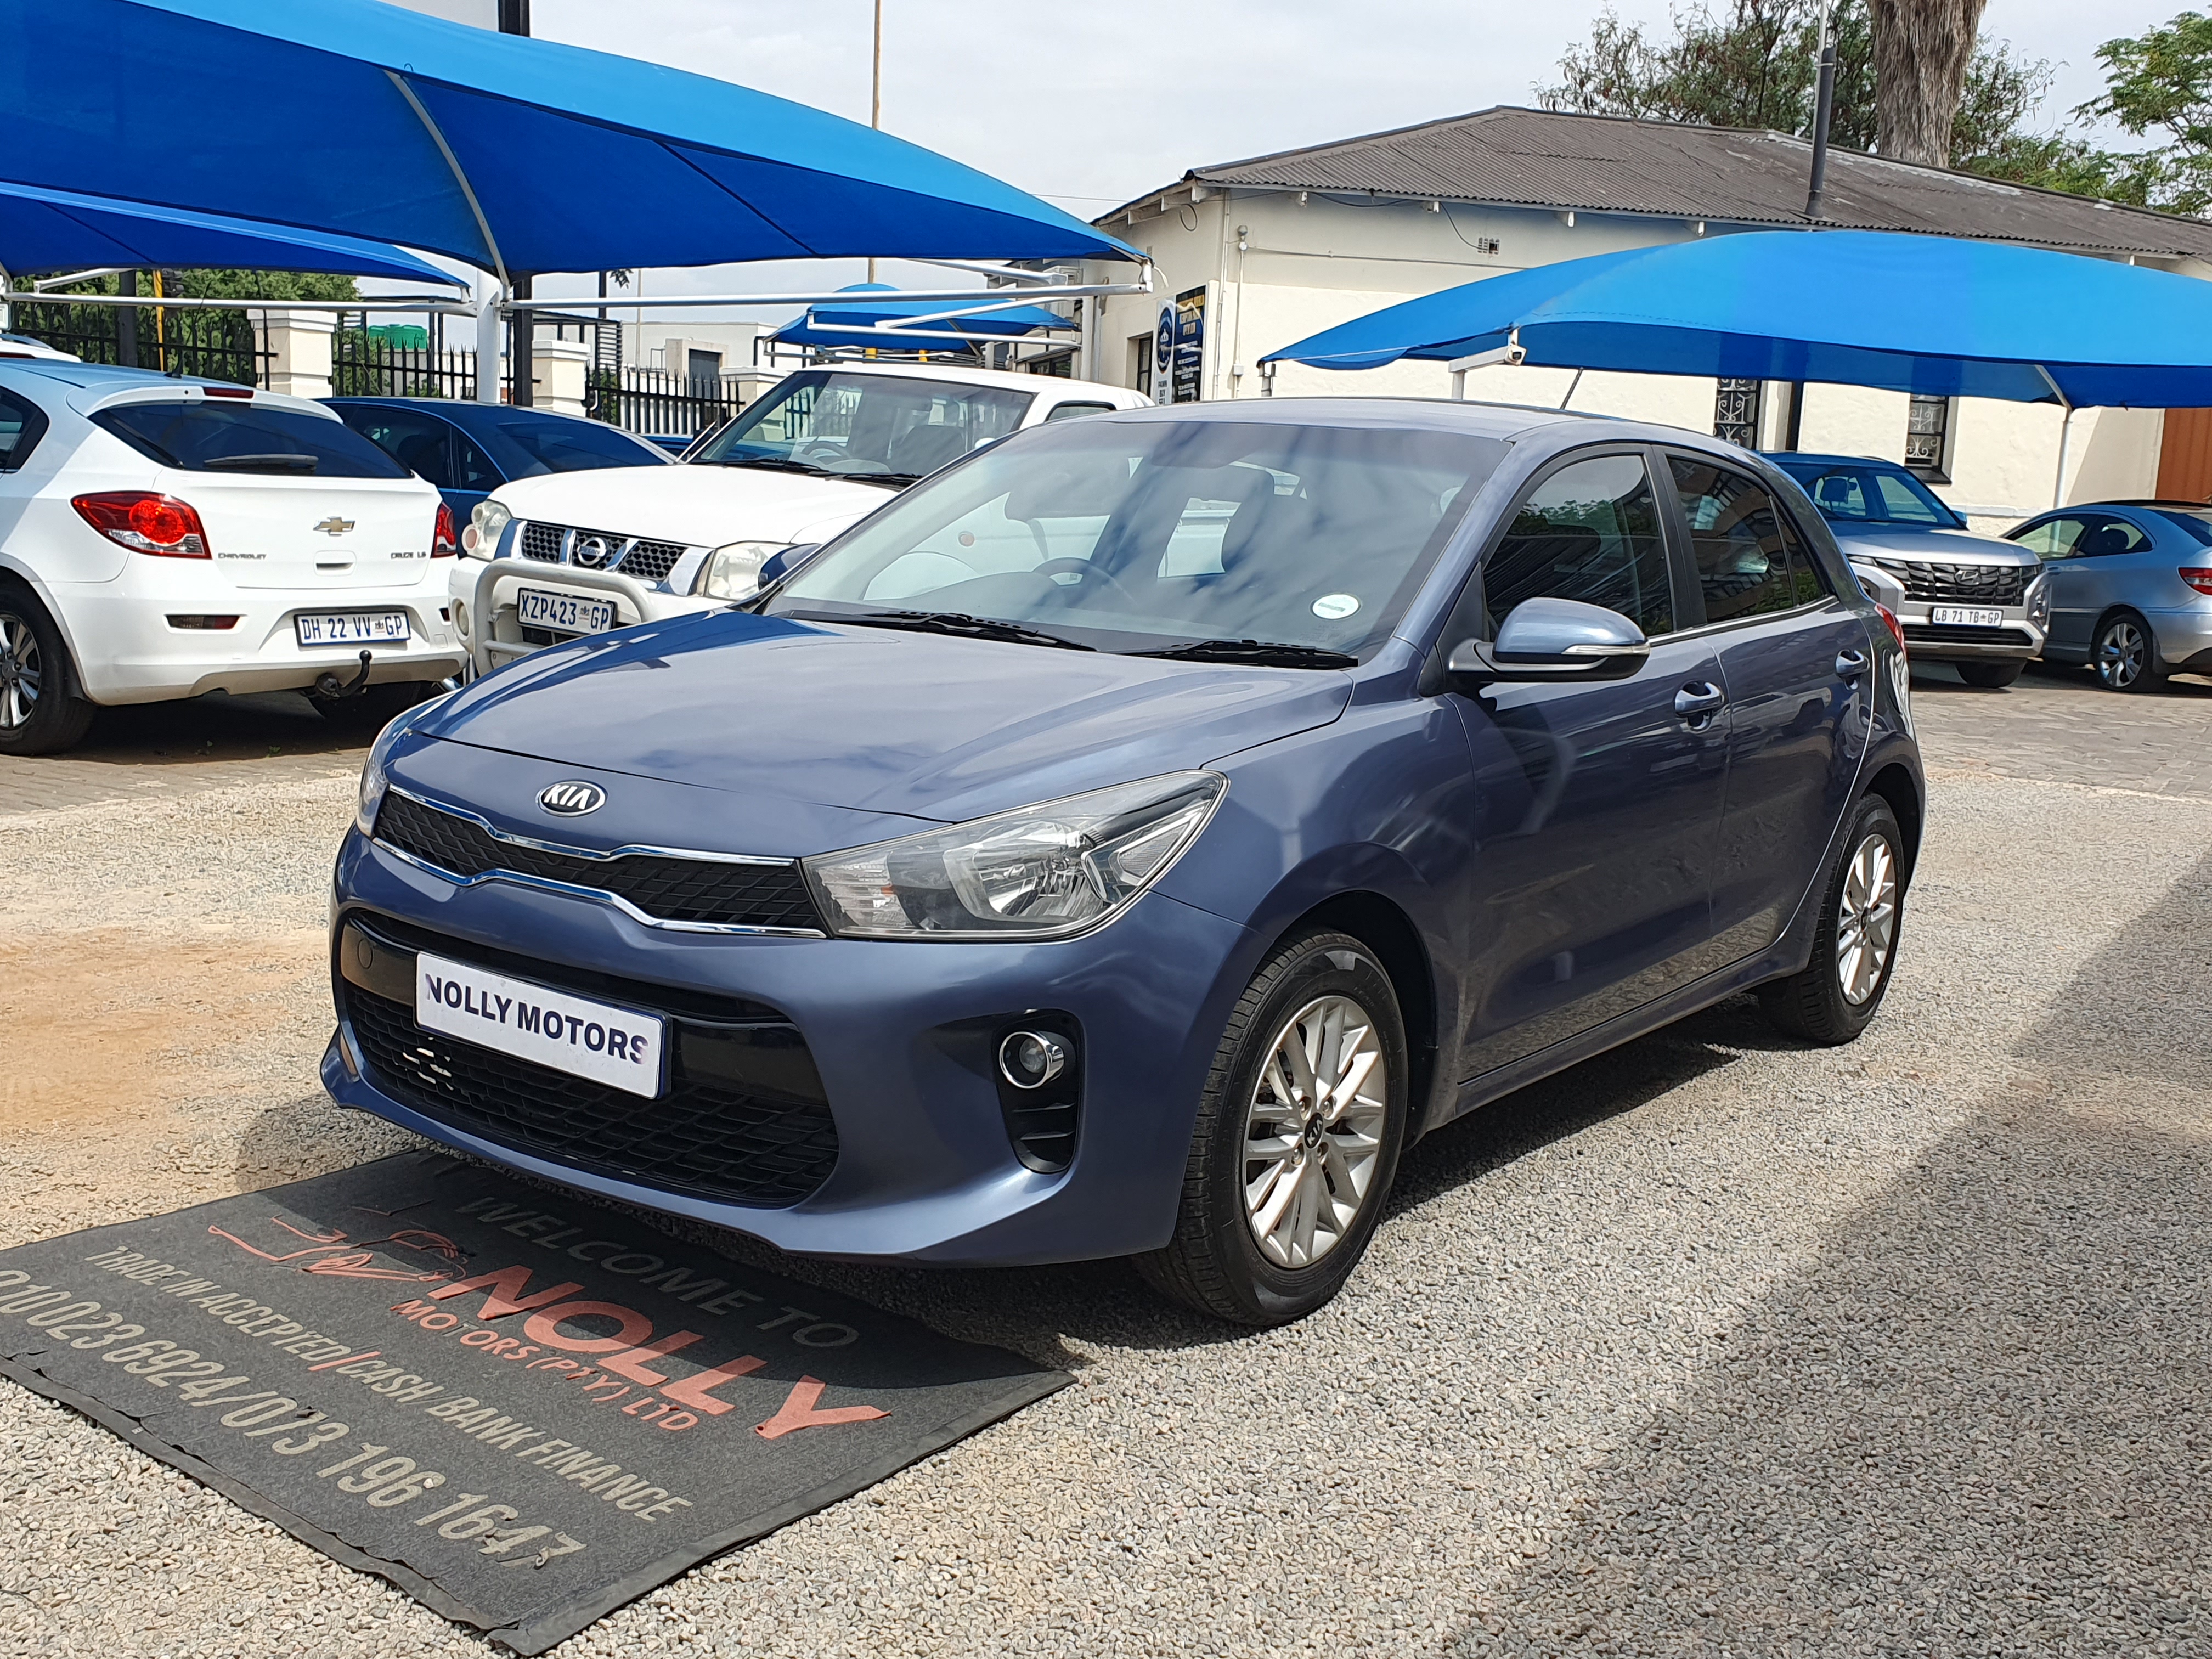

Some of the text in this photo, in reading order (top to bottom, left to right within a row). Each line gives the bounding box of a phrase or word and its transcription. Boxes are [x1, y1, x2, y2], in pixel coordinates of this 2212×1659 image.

[301, 615, 402, 640] DH 22 VV GP
[521, 594, 609, 631] XZP423 GP
[1935, 610, 1999, 624] LB 71 TB GP
[543, 784, 591, 808] KIA
[425, 973, 649, 1065] NOLLY MOTORS
[1306, 1119, 1323, 1146] KIA
[455, 1197, 860, 1348] WELCOME TO
[390, 1299, 541, 1360] MOTORS
[426, 1264, 893, 1438] NOLLY
[84, 1245, 192, 1286] TRADE
[160, 1277, 221, 1297] IN
[514, 1438, 694, 1523] FINANCE
[316, 1442, 446, 1508] 196
[413, 1493, 588, 1570] 1647
